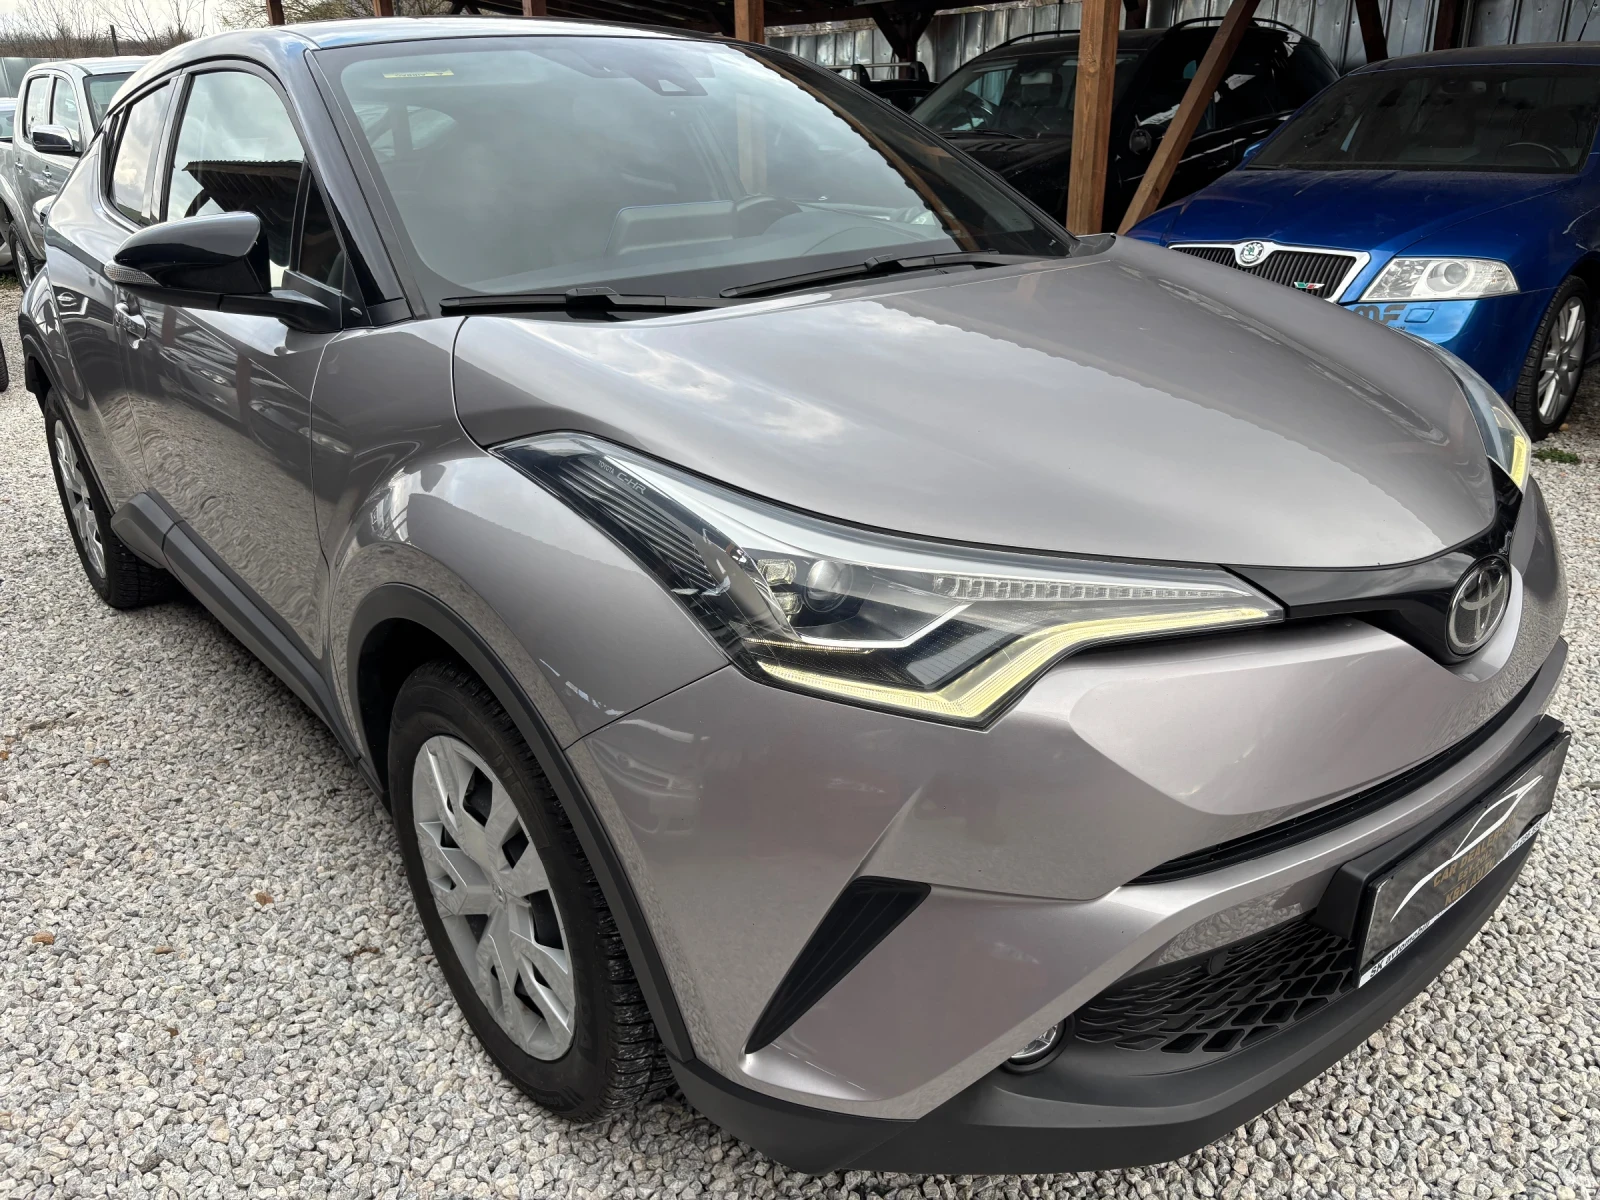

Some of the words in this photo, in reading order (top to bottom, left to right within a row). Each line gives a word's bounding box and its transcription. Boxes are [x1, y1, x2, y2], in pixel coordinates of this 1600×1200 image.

[598, 459, 615, 476] TOYOTA
[616, 472, 647, 495] C-HR
[1433, 861, 1459, 888] CAR
[1370, 960, 1384, 978] SK
